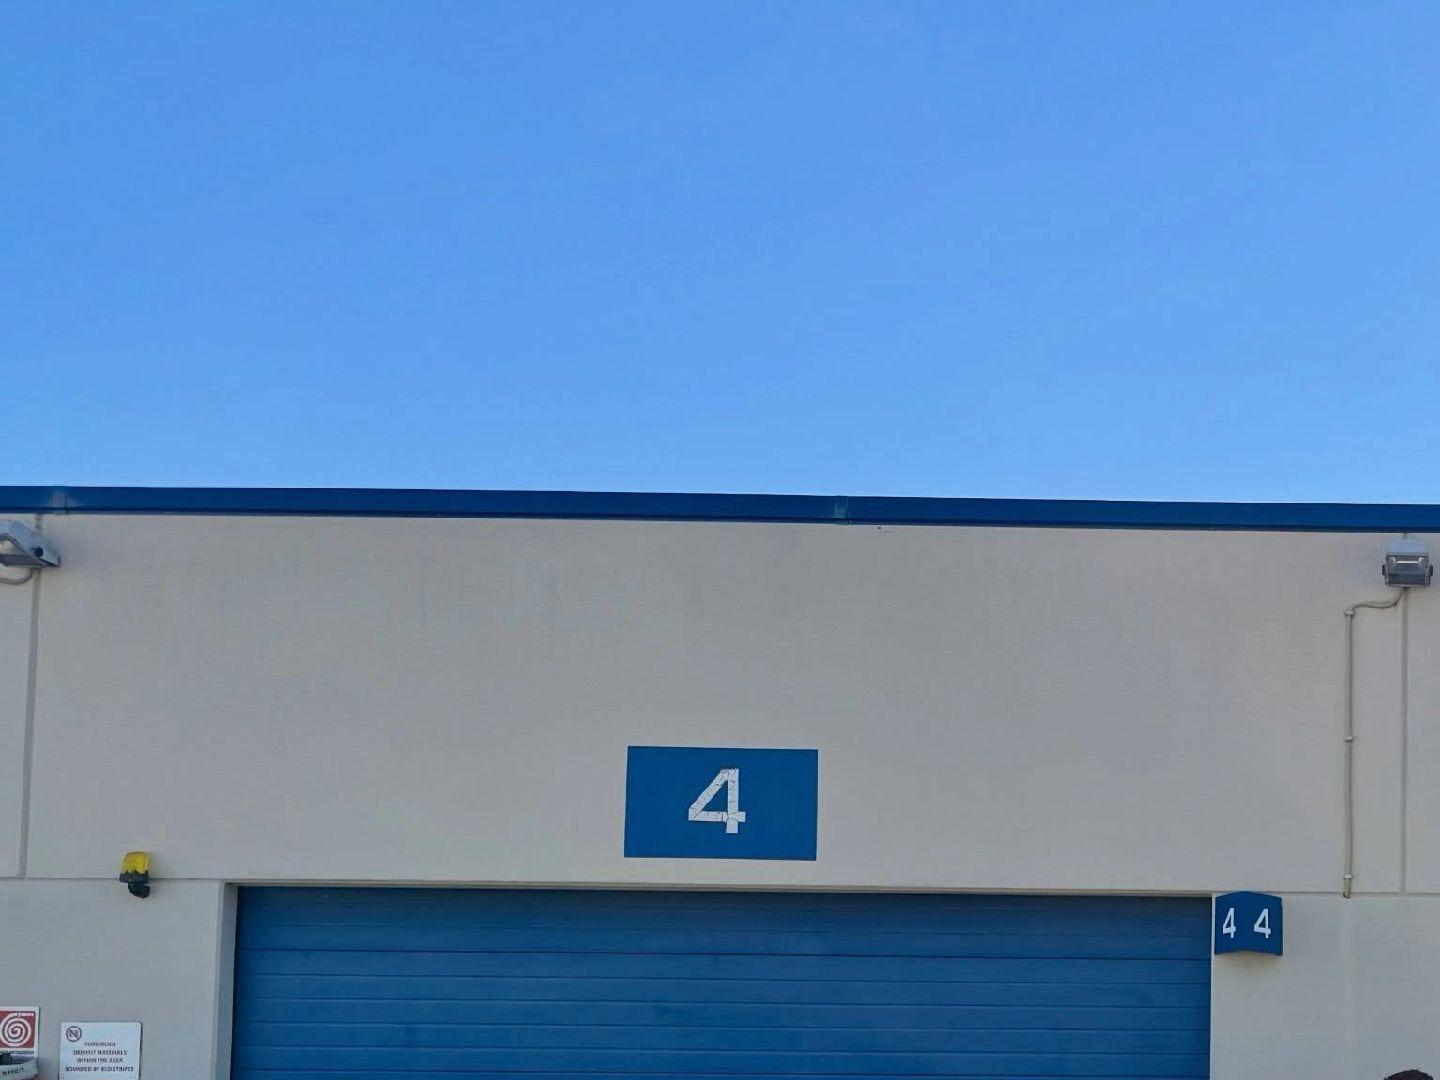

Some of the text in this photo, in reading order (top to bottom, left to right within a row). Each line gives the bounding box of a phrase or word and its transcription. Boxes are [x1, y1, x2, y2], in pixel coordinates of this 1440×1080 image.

[688, 768, 746, 834] 4
[1222, 907, 1237, 939] 4
[1253, 908, 1272, 939] 4
